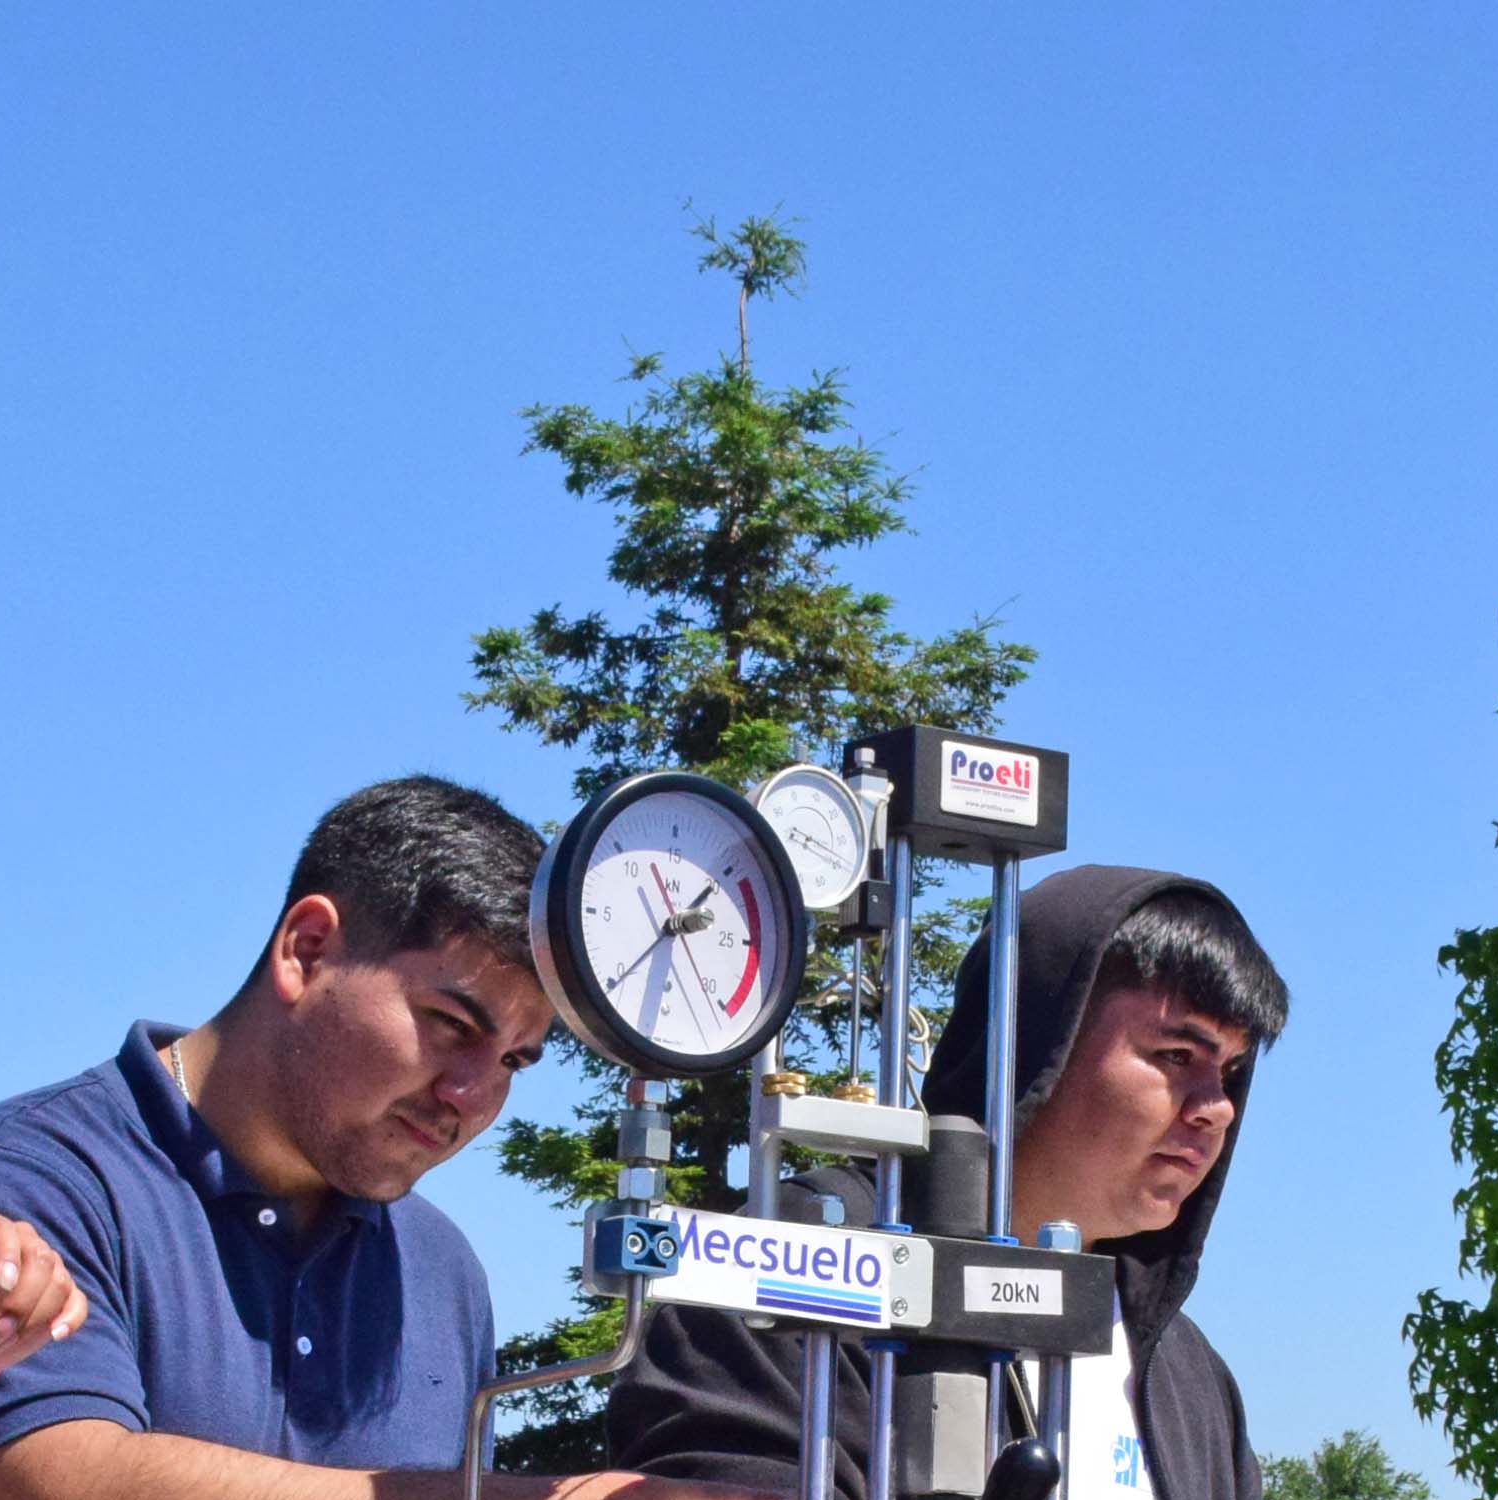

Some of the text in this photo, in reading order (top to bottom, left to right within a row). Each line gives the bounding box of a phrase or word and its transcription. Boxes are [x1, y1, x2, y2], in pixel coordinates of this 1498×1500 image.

[951, 750, 1030, 789] Proeti
[668, 847, 681, 865] 15
[624, 861, 639, 878] 10
[665, 877, 680, 893] kN
[603, 906, 612, 922] 5
[718, 931, 734, 948] 25
[616, 961, 625, 978] 0
[701, 976, 717, 994] 30
[669, 1209, 882, 1288] Mecsuelo
[991, 1282, 1040, 1304] 20kN
